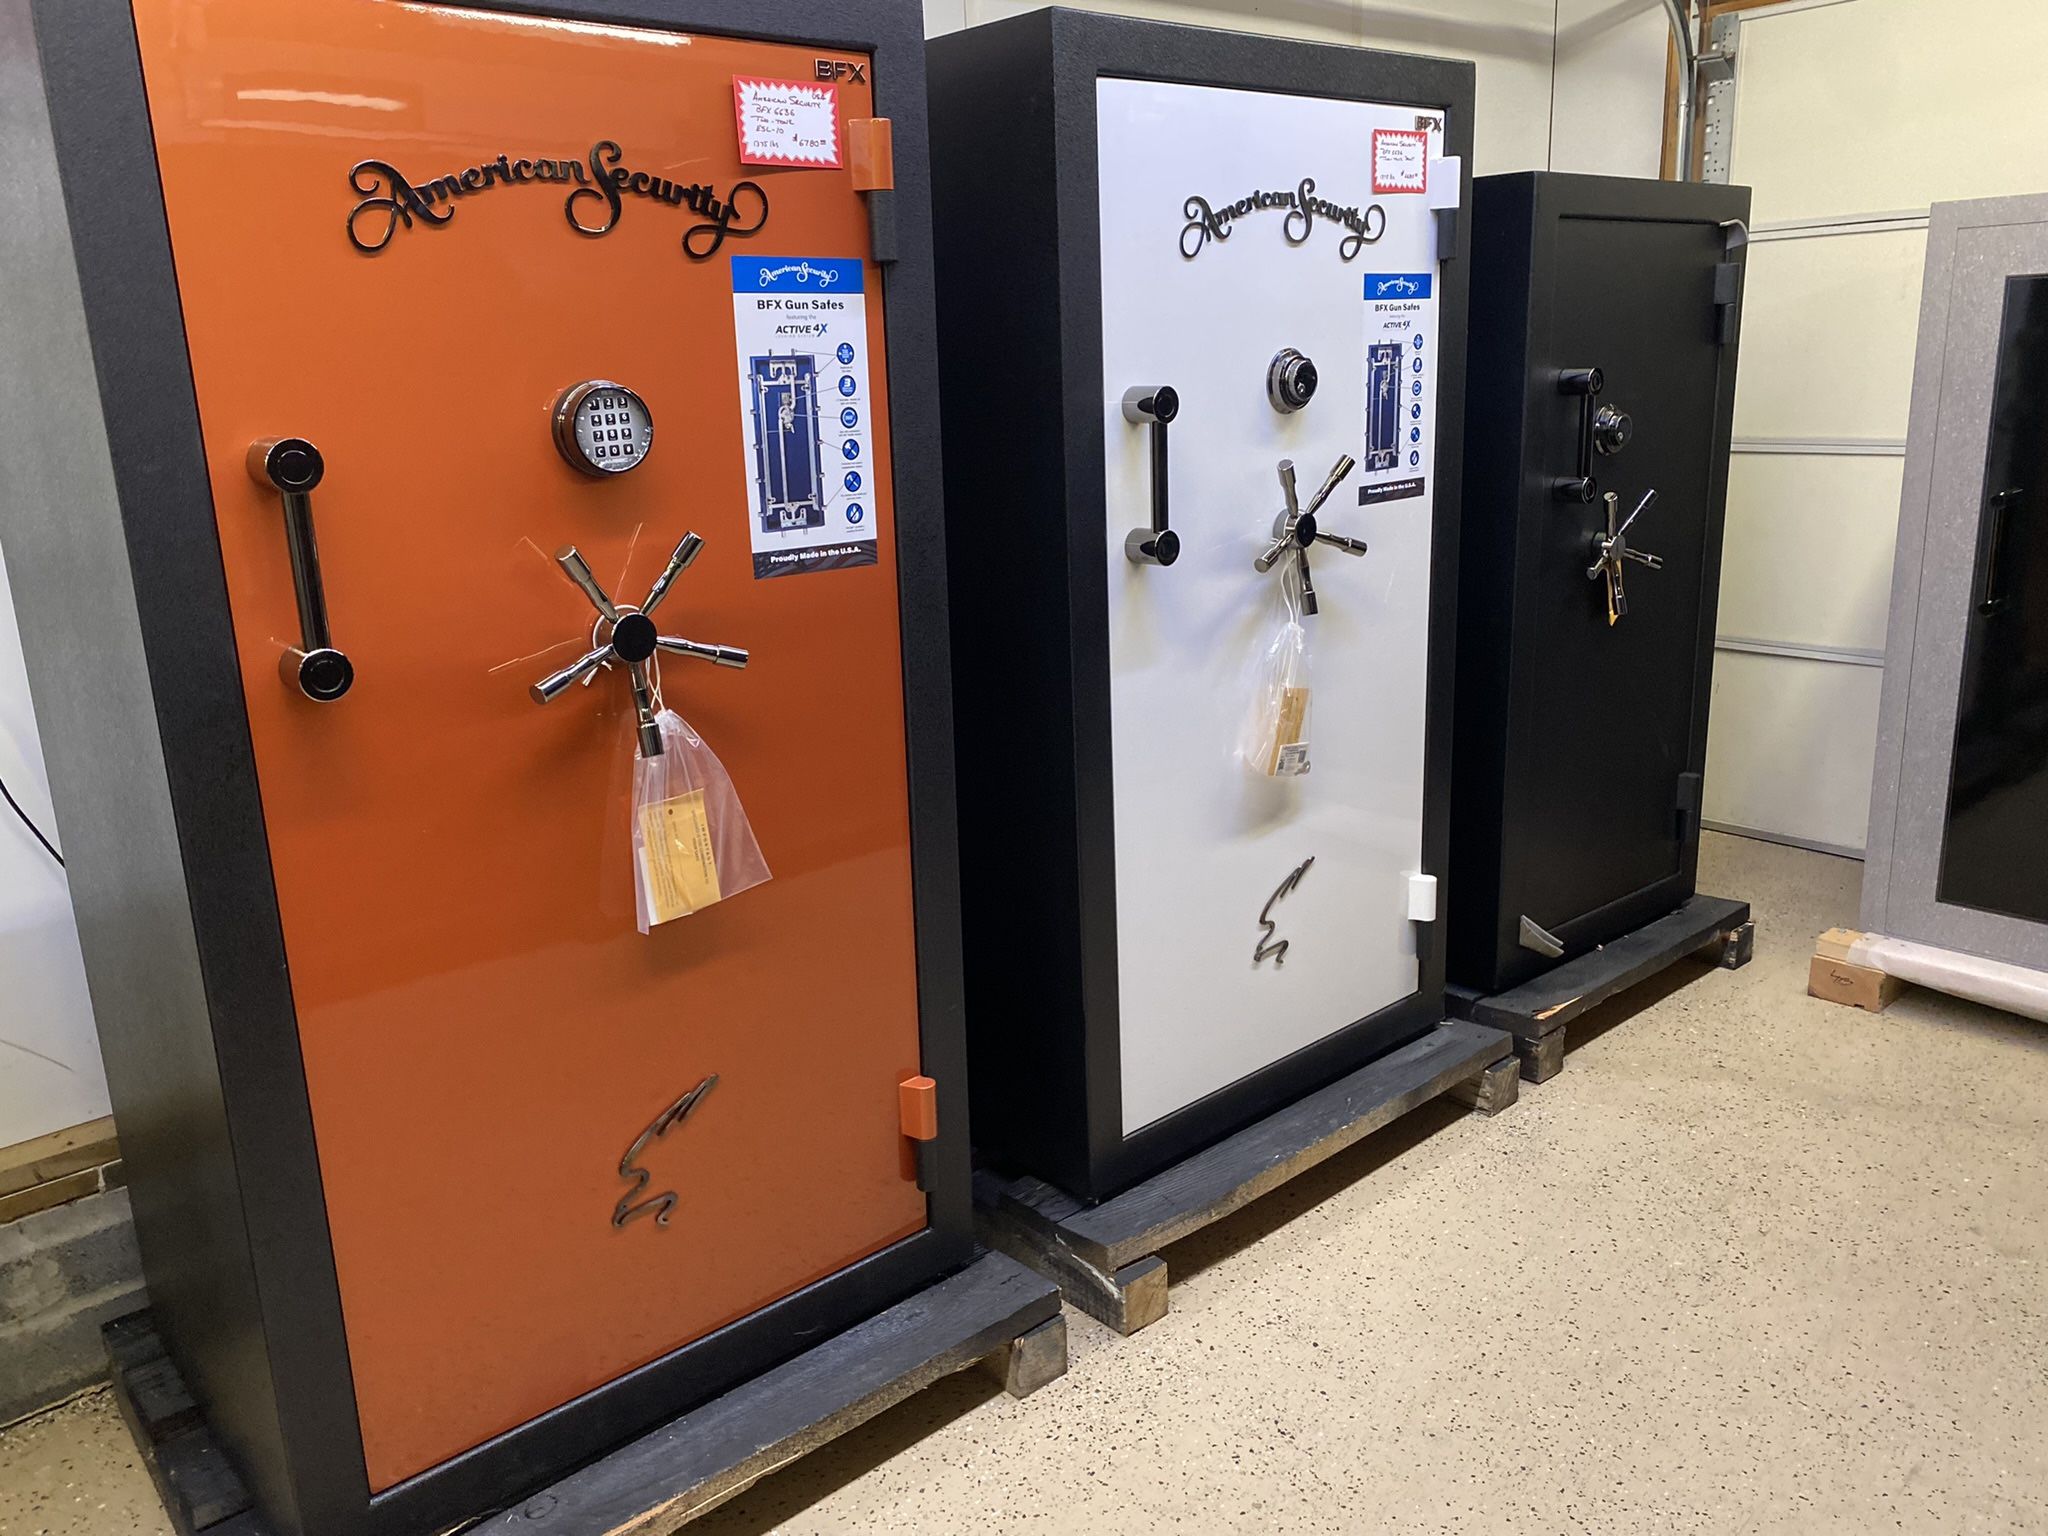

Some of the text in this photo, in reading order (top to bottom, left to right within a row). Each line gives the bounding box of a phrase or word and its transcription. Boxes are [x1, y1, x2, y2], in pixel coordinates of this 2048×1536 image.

[814, 58, 866, 85] BFX
[774, 107, 796, 116] 6636
[346, 140, 769, 262] American Security
[1179, 177, 1386, 261] American Security
[759, 261, 838, 288] American Security
[757, 300, 845, 310] BFX Gun Safes
[1402, 303, 1420, 311] Safes
[776, 323, 828, 337] ACTIVE 4X
[1383, 321, 1402, 329] ACTIVE
[770, 553, 799, 563] Proudly
[799, 551, 819, 560] Made
[827, 548, 840, 556] the
[840, 546, 862, 555] U.S.A.
